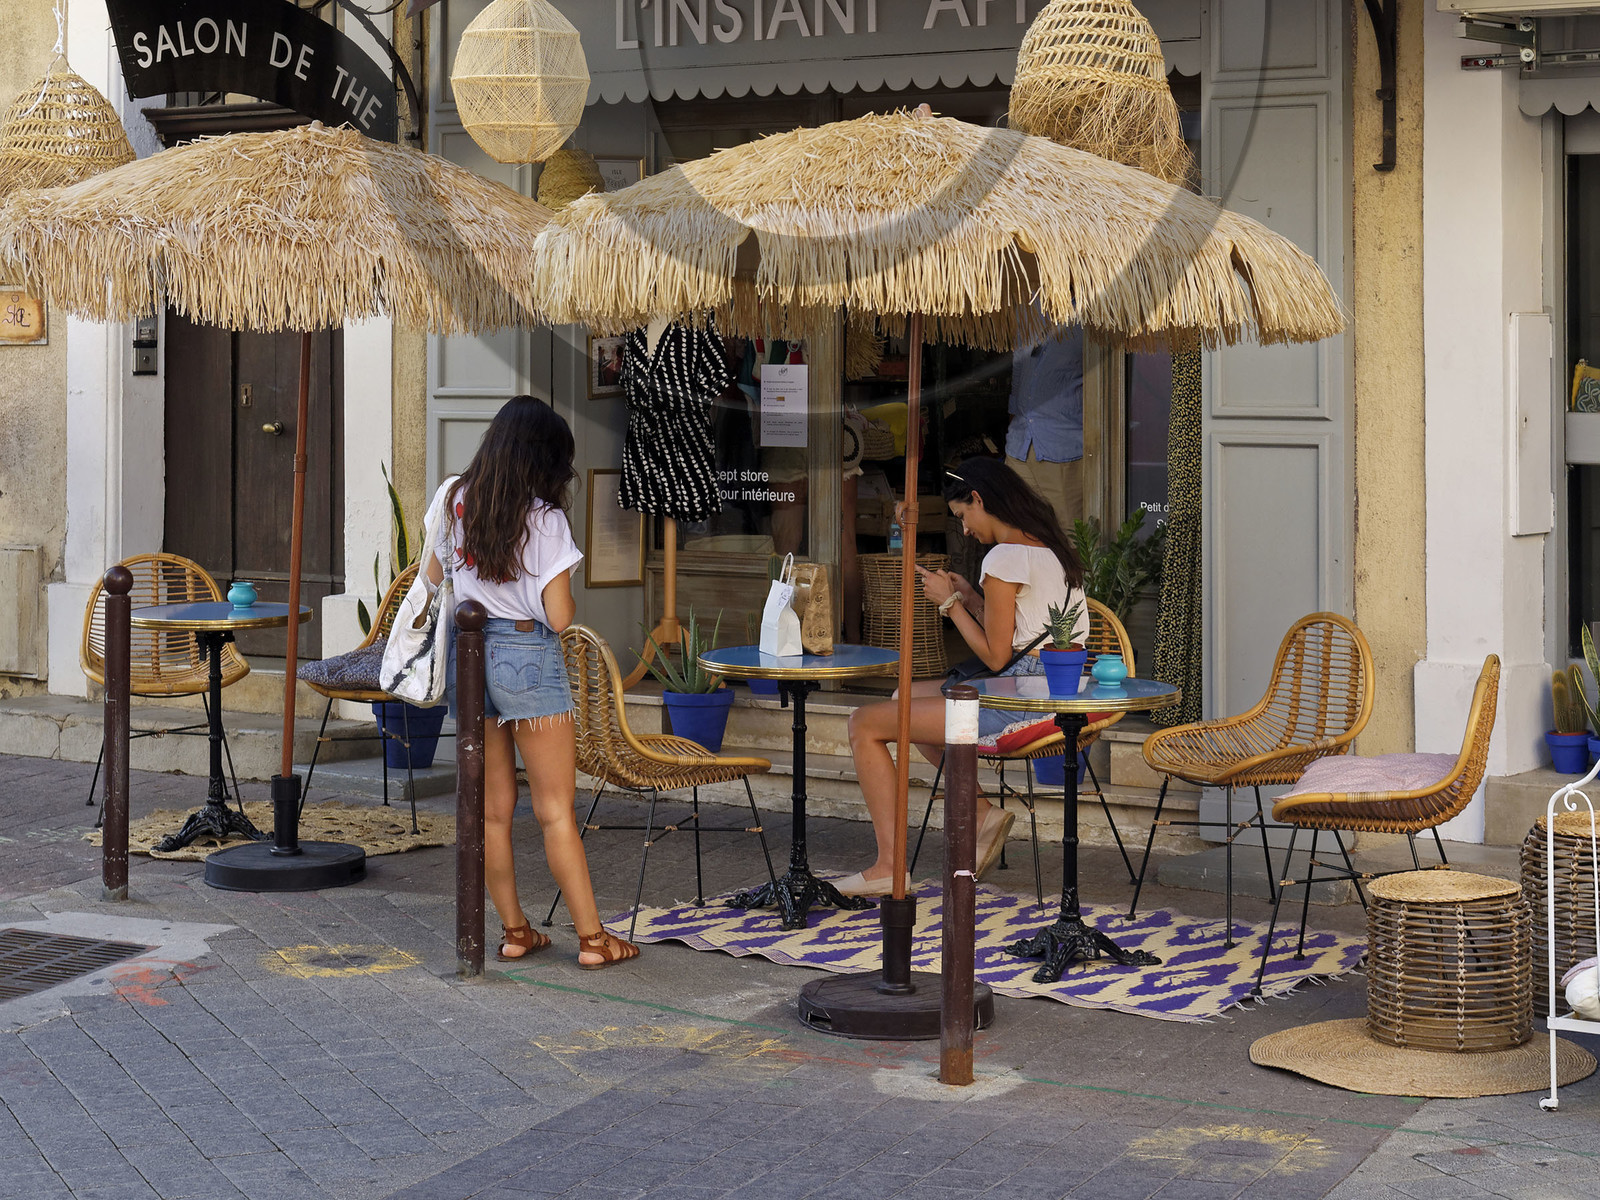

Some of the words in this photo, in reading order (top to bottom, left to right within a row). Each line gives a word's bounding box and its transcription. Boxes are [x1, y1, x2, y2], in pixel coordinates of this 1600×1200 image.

[133, 17, 248, 69] SALON
[269, 31, 315, 81] DE
[330, 64, 383, 130] THE
[740, 469, 769, 482] store
[719, 489, 739, 501] our
[741, 488, 795, 502] intérieure
[1140, 501, 1161, 512] Petit
